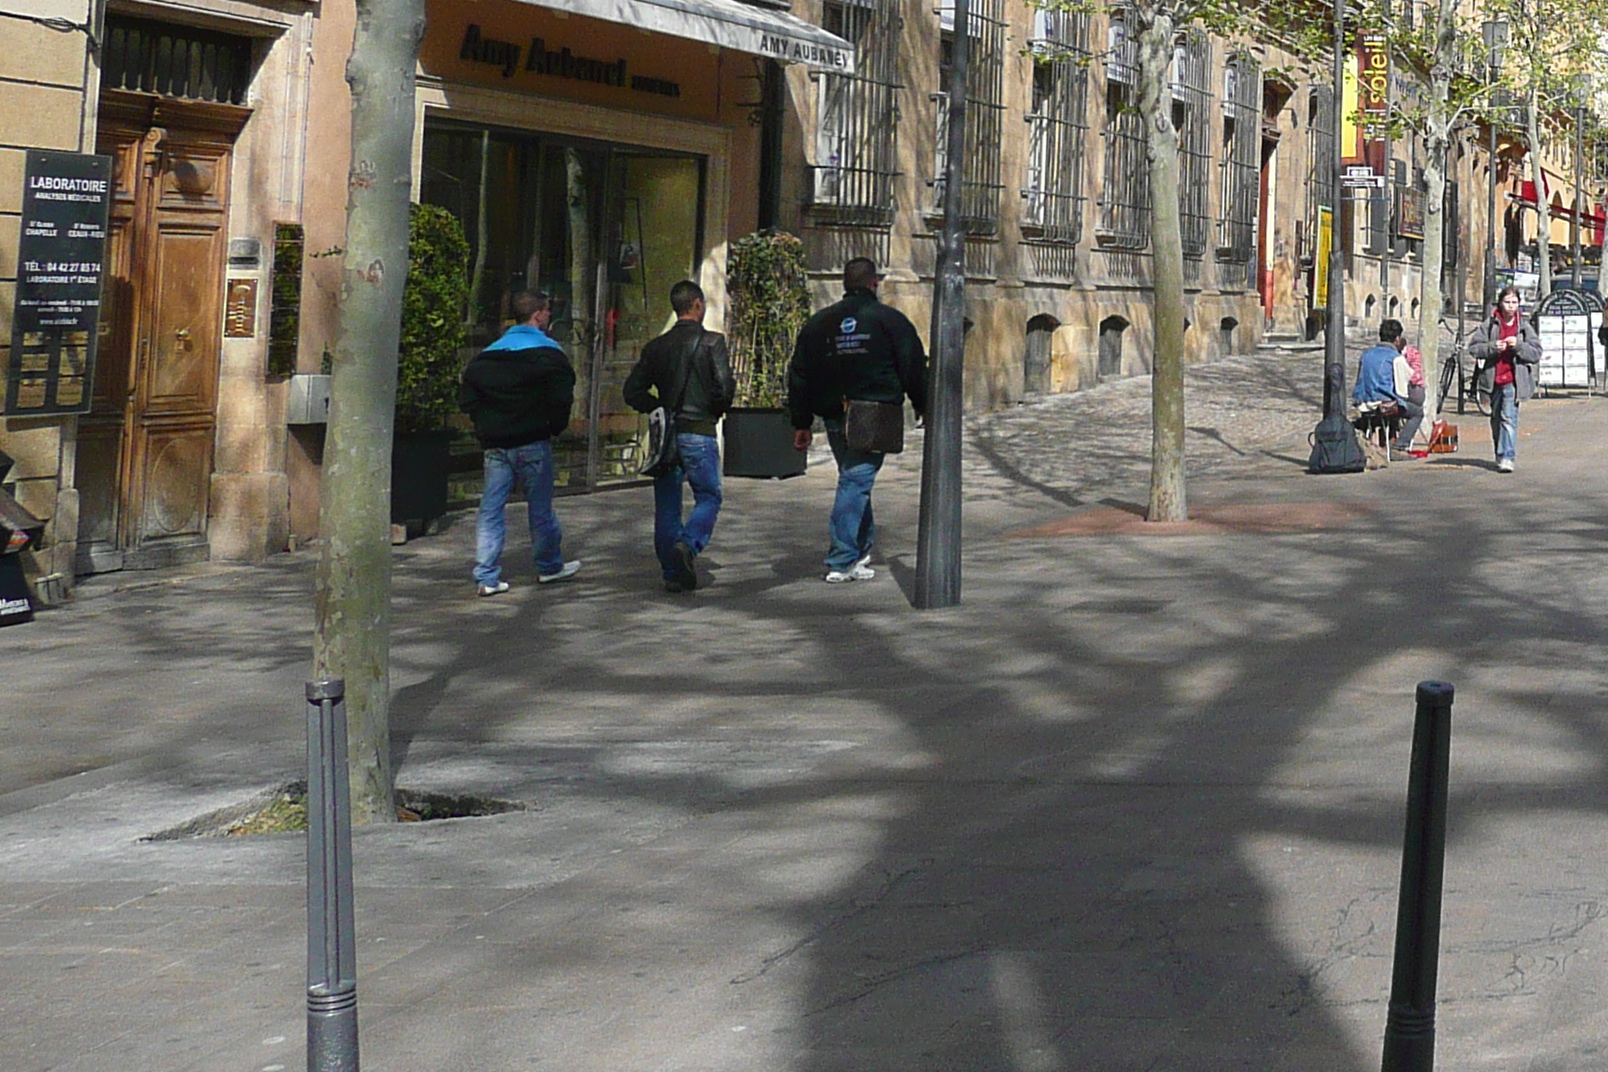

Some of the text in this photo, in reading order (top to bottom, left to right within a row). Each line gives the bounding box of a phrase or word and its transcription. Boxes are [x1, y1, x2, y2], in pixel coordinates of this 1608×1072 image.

[460, 24, 521, 77] Amy
[760, 34, 788, 55] AMY
[31, 176, 107, 193] LABORATOIRE
